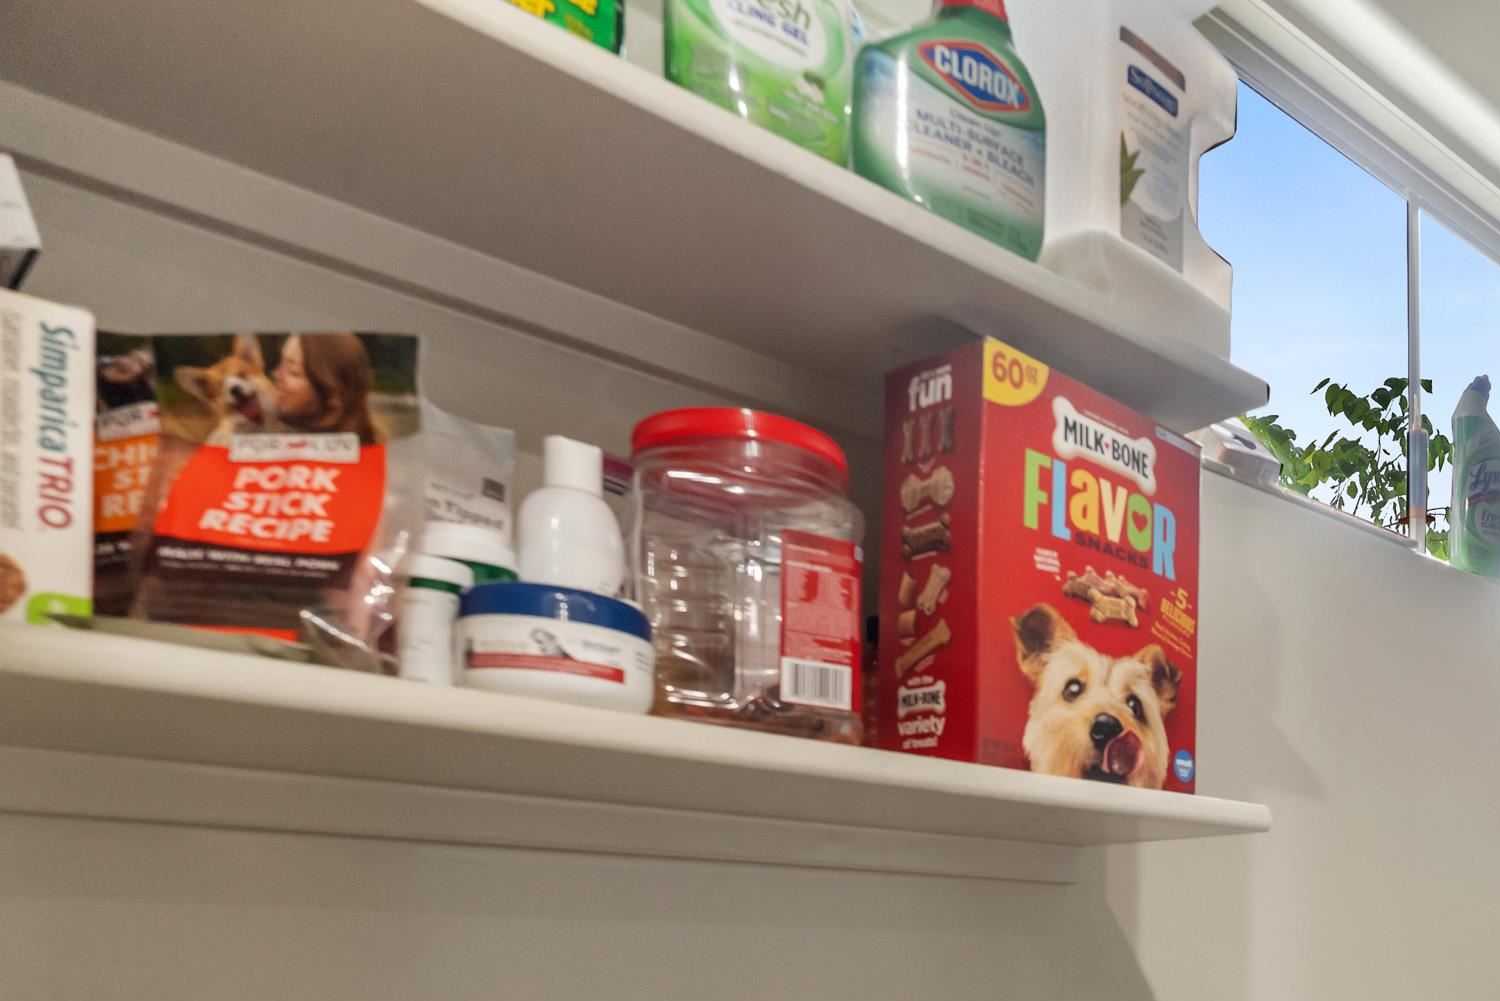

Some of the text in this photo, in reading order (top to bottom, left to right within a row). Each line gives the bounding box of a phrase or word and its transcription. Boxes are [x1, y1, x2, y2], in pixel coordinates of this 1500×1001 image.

[934, 44, 1019, 109] CLOROX
[909, 121, 972, 151] CLEANER
[987, 150, 1035, 187] BLEACH
[916, 109, 1024, 166] MULTI-SURFACE
[992, 351, 1024, 389] 60
[908, 373, 952, 411] fun
[29, 322, 79, 529] Simparica TRIO
[233, 466, 340, 492] PORK
[223, 491, 331, 517] STICK
[198, 508, 335, 542] RECIPE
[1076, 533, 1149, 569] SNACKS
[897, 715, 946, 736] variety
